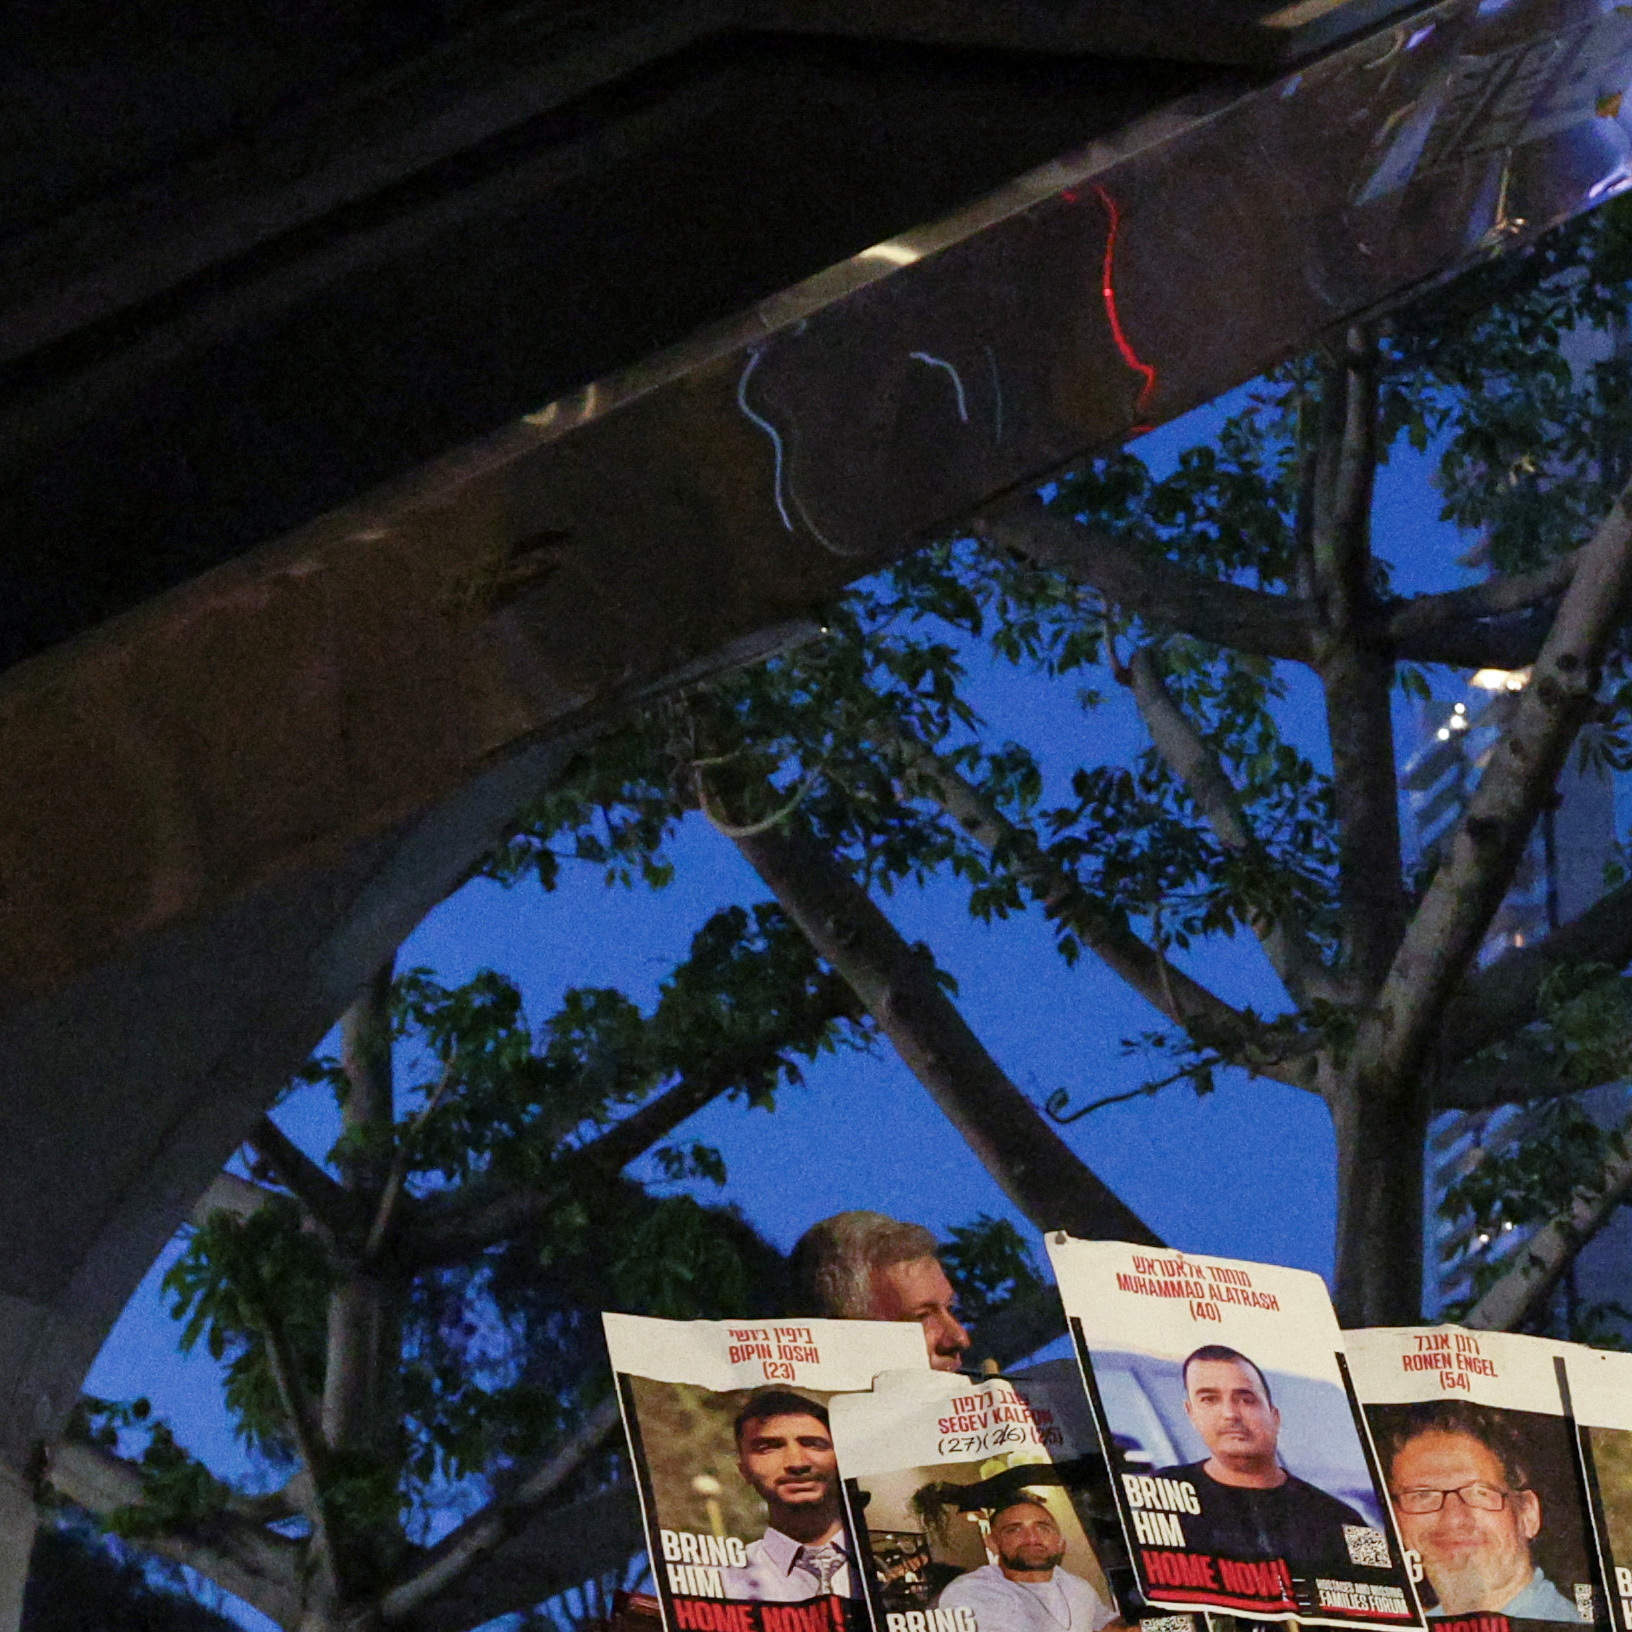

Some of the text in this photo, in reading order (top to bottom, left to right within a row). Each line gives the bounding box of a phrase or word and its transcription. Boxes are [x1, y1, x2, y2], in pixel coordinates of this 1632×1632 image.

[1116, 1272, 1280, 1312] MUHAMMAD ALATRASH
[1189, 1300, 1222, 1323] (40)
[729, 1344, 820, 1364] BIPIN JOSHI
[1402, 1352, 1498, 1378] RONEN ENGEL
[762, 1361, 796, 1381] (23)
[1440, 1370, 1471, 1393] (54)
[938, 1412, 988, 1434] SEGEV
[1121, 1473, 1201, 1515] BRING
[1131, 1509, 1187, 1547] HIM
[660, 1529, 748, 1568] BRING
[666, 1563, 726, 1598] HIM
[1142, 1551, 1295, 1597] HOME NOW!
[1319, 1590, 1409, 1614] FAMILIES FORUM
